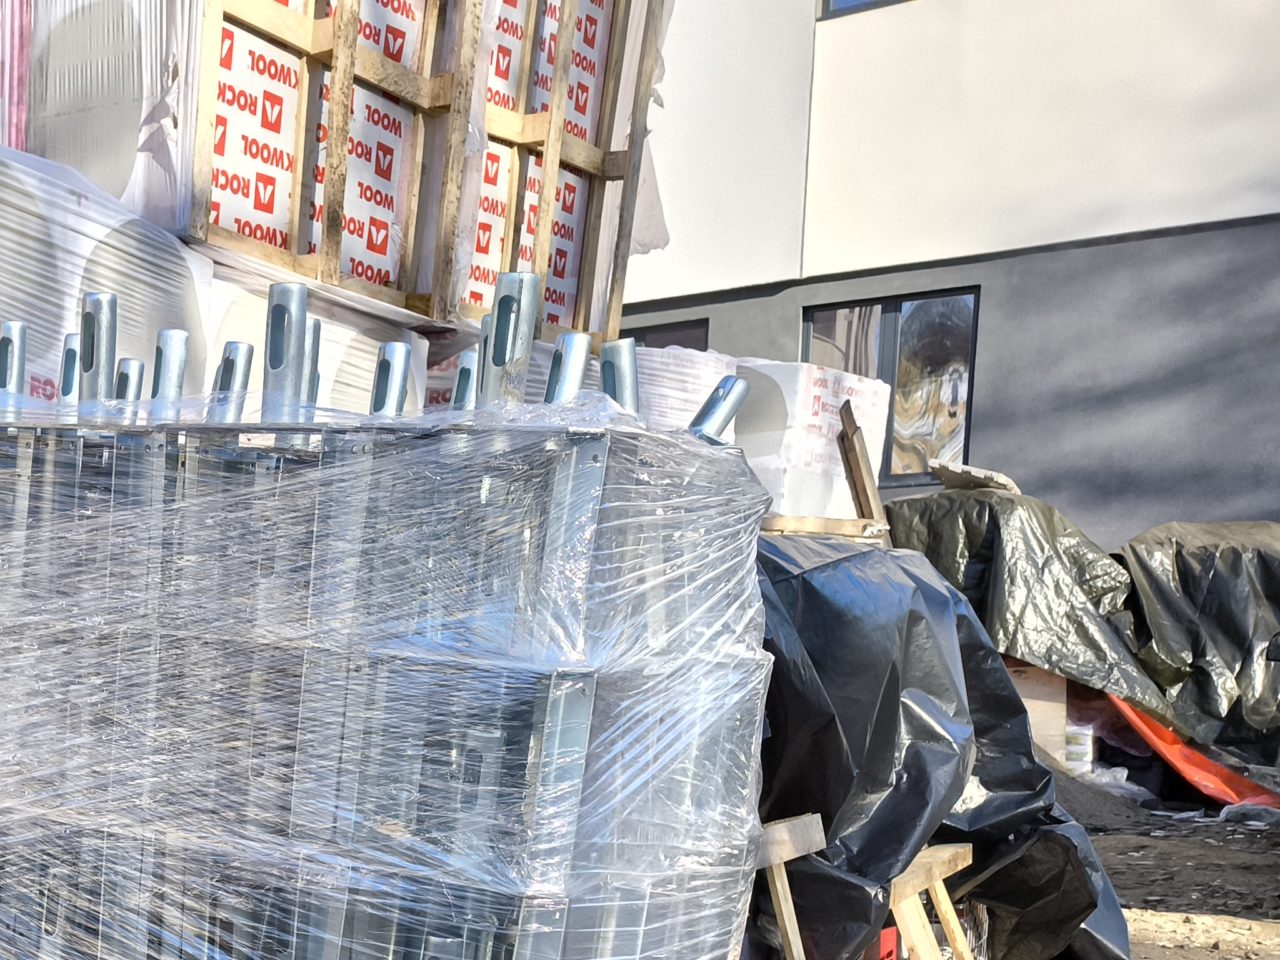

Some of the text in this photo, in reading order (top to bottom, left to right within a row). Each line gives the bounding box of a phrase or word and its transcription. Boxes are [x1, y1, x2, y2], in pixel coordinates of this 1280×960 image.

[365, 104, 402, 138] WOOL
[241, 134, 294, 173] KWOOL
[357, 181, 394, 213] WOOL
[234, 217, 288, 250] KWOOL
